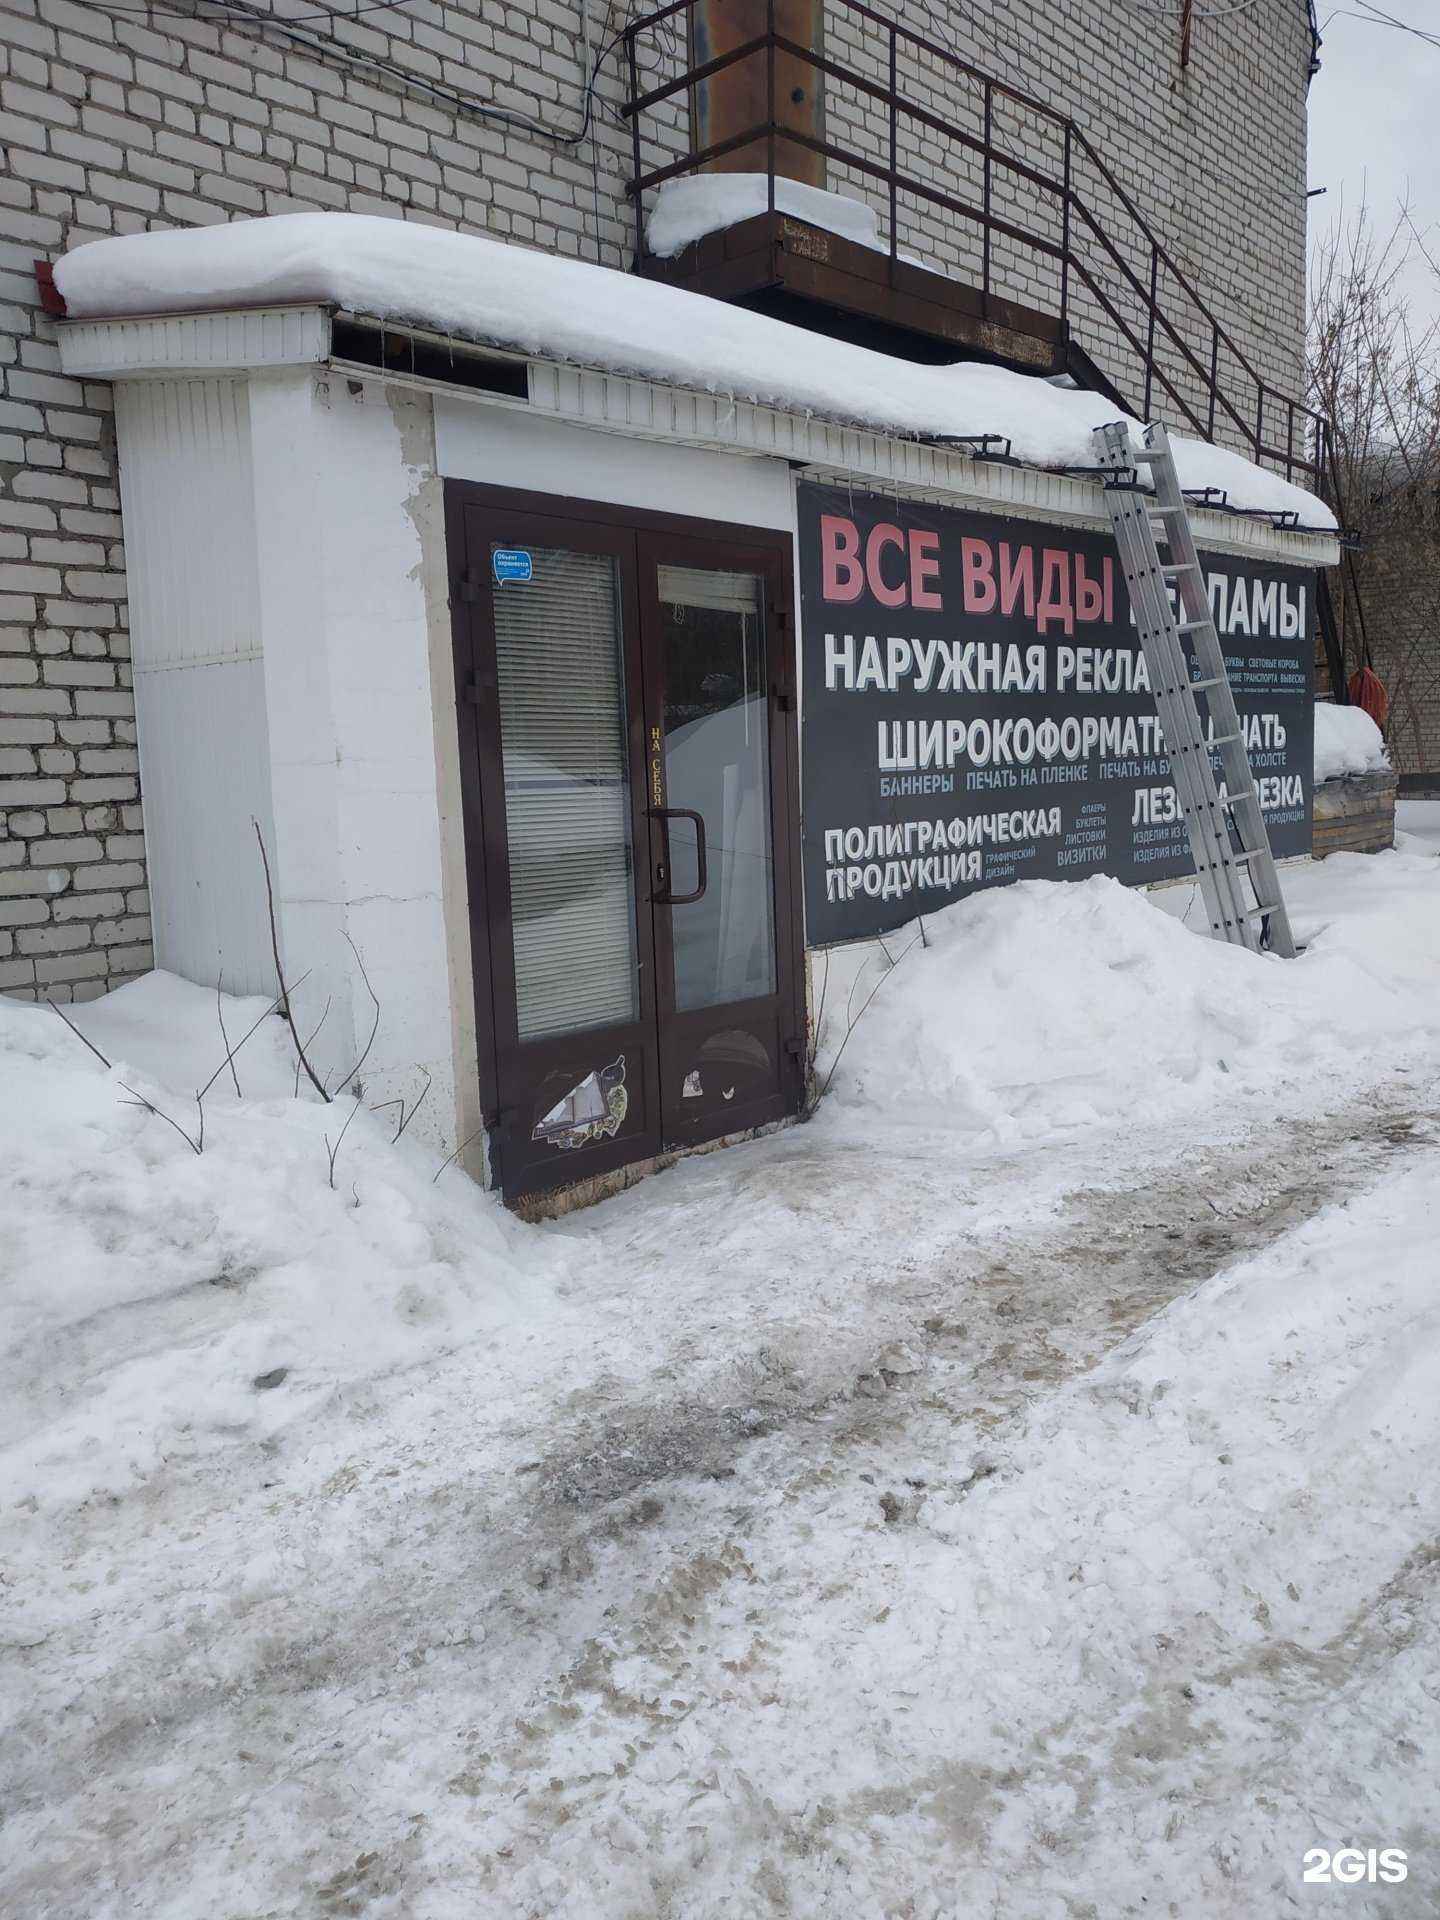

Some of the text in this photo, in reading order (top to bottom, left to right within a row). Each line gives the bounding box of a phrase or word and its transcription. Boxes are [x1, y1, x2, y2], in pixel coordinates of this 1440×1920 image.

[821, 514, 1307, 640] ВСЕ ВИДЫ ЛАМЫ
[824, 633, 1152, 695] НАРУЖНАЯ РЕКЛА
[1278, 659, 1299, 670] КОРОБА
[1280, 674, 1306, 684] ВЫВЕСКИ
[651, 727, 662, 806] НА СЕБЯ
[879, 774, 954, 798] БАННЕРЫ
[966, 769, 1018, 791] ПЕЧАТЬ
[1020, 767, 1038, 784] НА
[1041, 764, 1089, 784] ПЛЕНКЕ
[1099, 759, 1140, 780] ПЕЧАТЬ
[1143, 760, 1158, 776] НА
[1256, 752, 1287, 767] ХОЛСТЕ
[1075, 817, 1107, 829] БУКЛЕТЫ
[1268, 810, 1305, 825] ПРОДУКЦИЯ
[824, 806, 1062, 864] ПОЛИГРАФИЧЕСКАЯ
[1064, 829, 1106, 846] ЛИСТОВКИ
[1133, 828, 1169, 844] ИЗДЕЛИЯ
[1170, 827, 1181, 838] ИЗ
[985, 847, 1036, 865] ГРАФИЧЕСКИЙ
[1056, 846, 1107, 867] ВИЗИТКИ
[1133, 847, 1170, 863] ИЗДЕЛИЯ
[1171, 846, 1182, 857] ИЗ
[825, 850, 983, 903] ПРОДУКЦИЯ
[985, 864, 1015, 880] ДИЗАЙН
